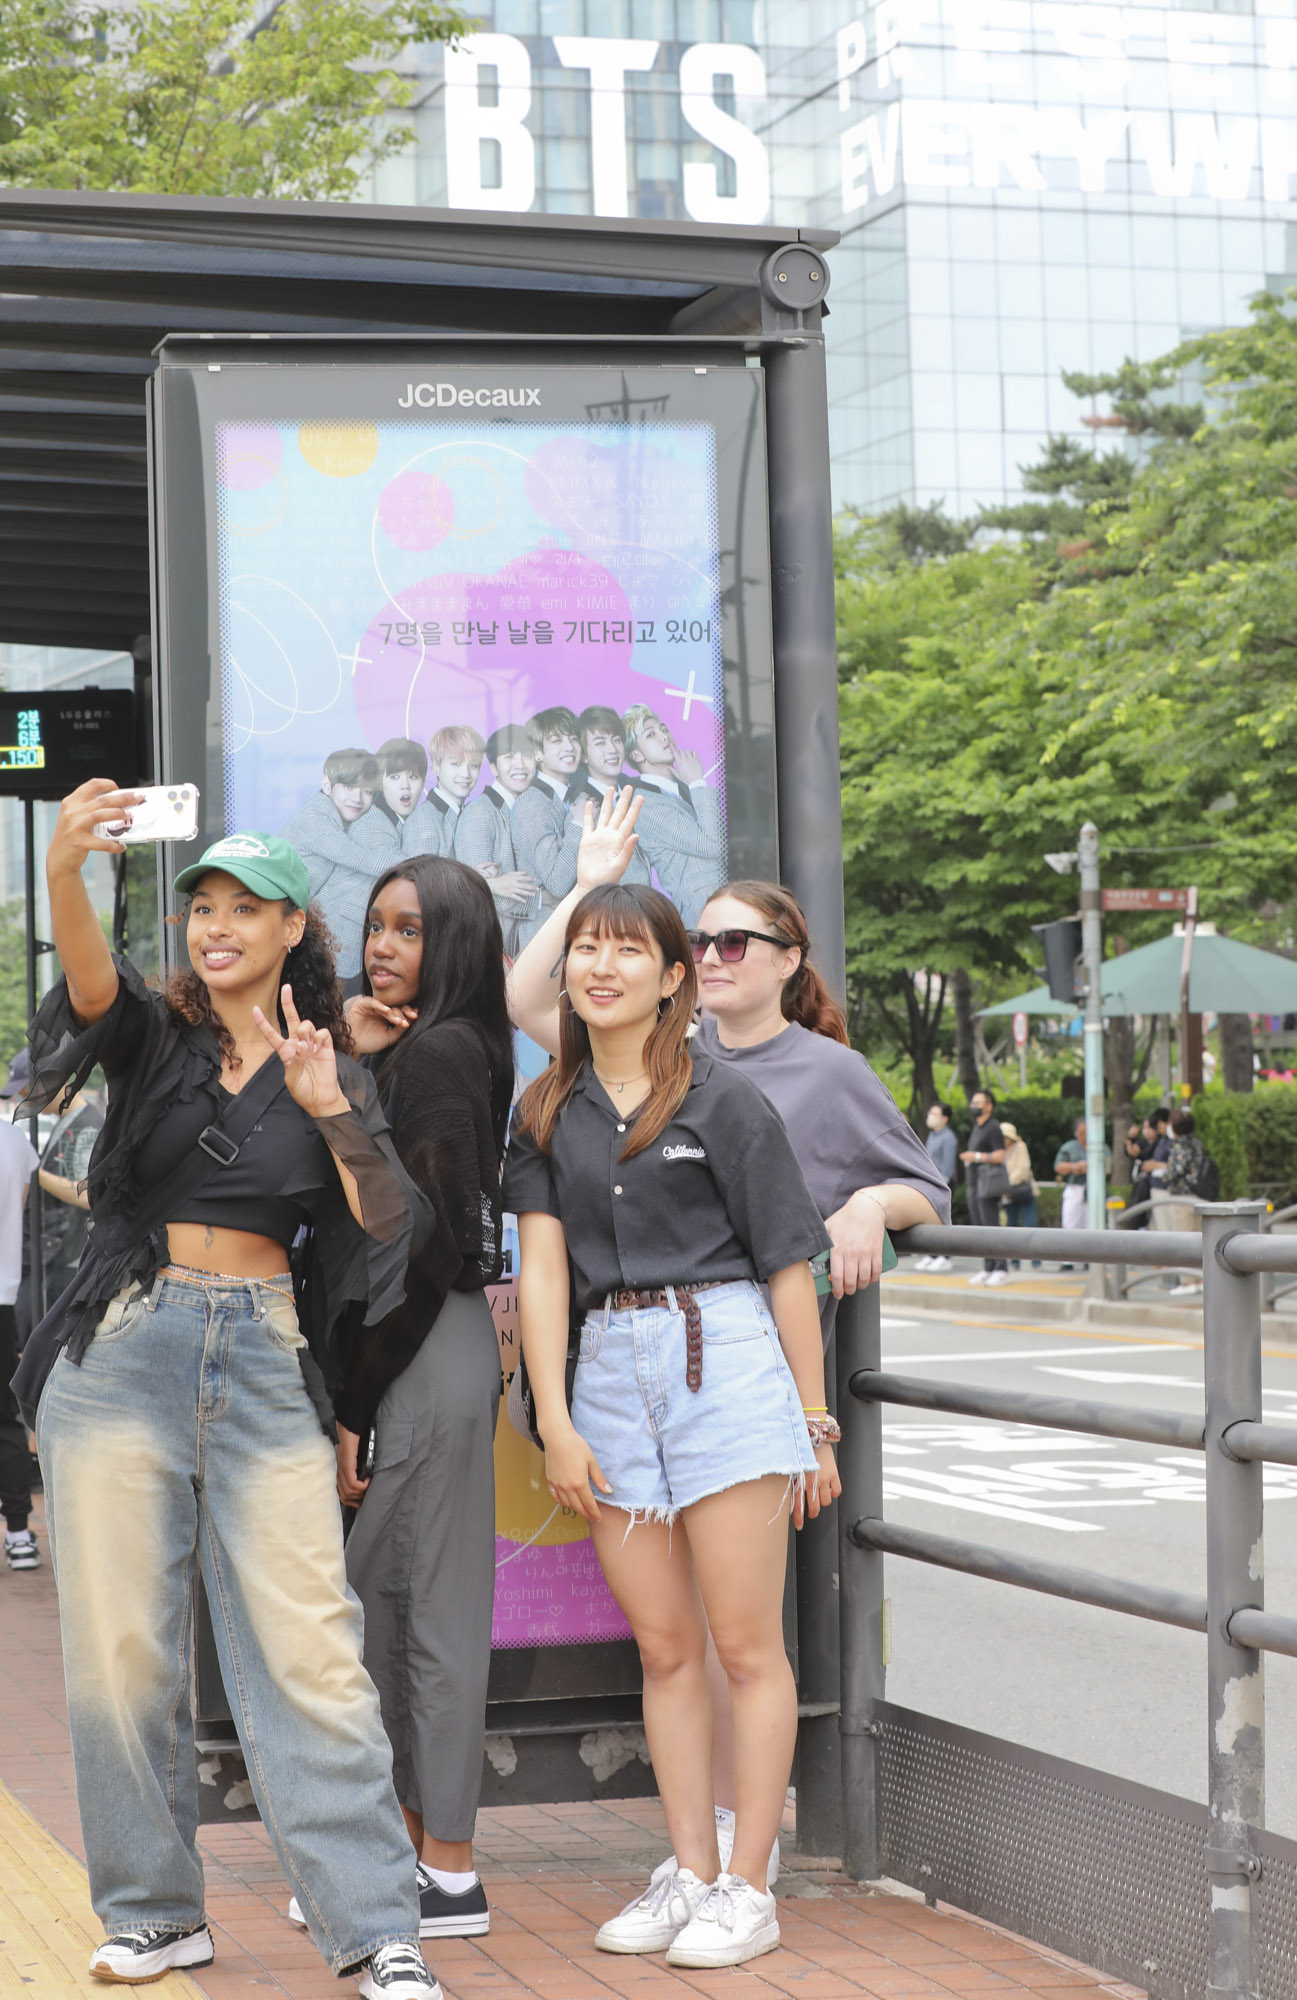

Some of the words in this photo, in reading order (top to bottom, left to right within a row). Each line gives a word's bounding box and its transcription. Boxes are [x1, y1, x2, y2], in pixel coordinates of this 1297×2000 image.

[444, 33, 769, 225] BTS
[398, 383, 542, 408] JCDecaux
[536, 572, 608, 589] marick39
[540, 595, 568, 611] emi
[576, 594, 619, 611] KIMIE
[378, 622, 443, 646] 7명을
[452, 621, 499, 646] 만날
[507, 620, 555, 645] 날을
[562, 619, 658, 645] 기다리고
[664, 619, 711, 644] 있어
